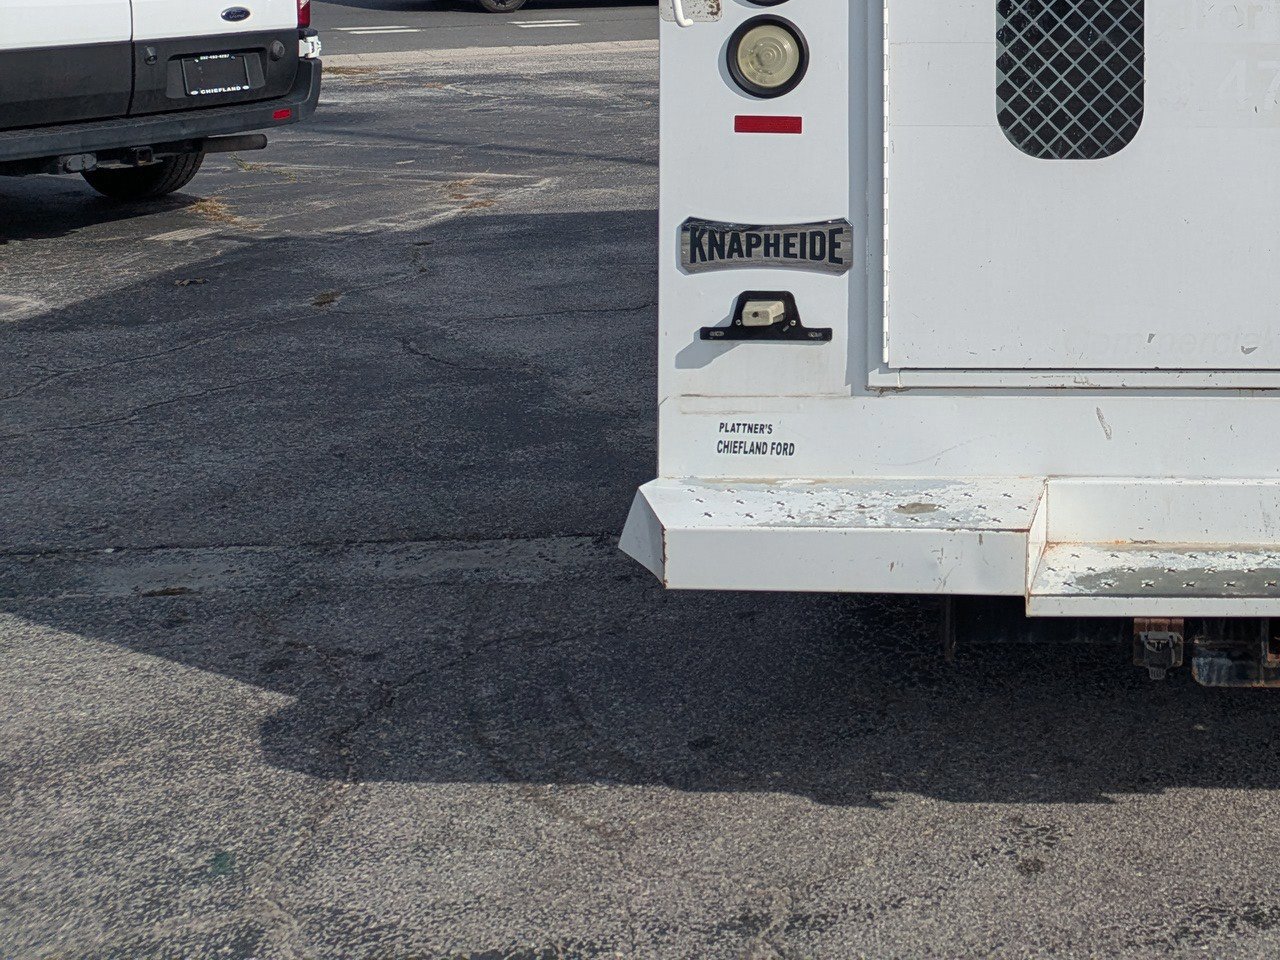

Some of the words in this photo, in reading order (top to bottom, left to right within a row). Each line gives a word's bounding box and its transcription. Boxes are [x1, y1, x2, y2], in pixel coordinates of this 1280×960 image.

[200, 86, 241, 95] CHIEFLAND
[689, 225, 844, 265] KNAPHEIDE
[718, 422, 773, 435] PLATTNER'S
[716, 440, 769, 456] CHIEFLAND
[770, 442, 795, 457] FORD
